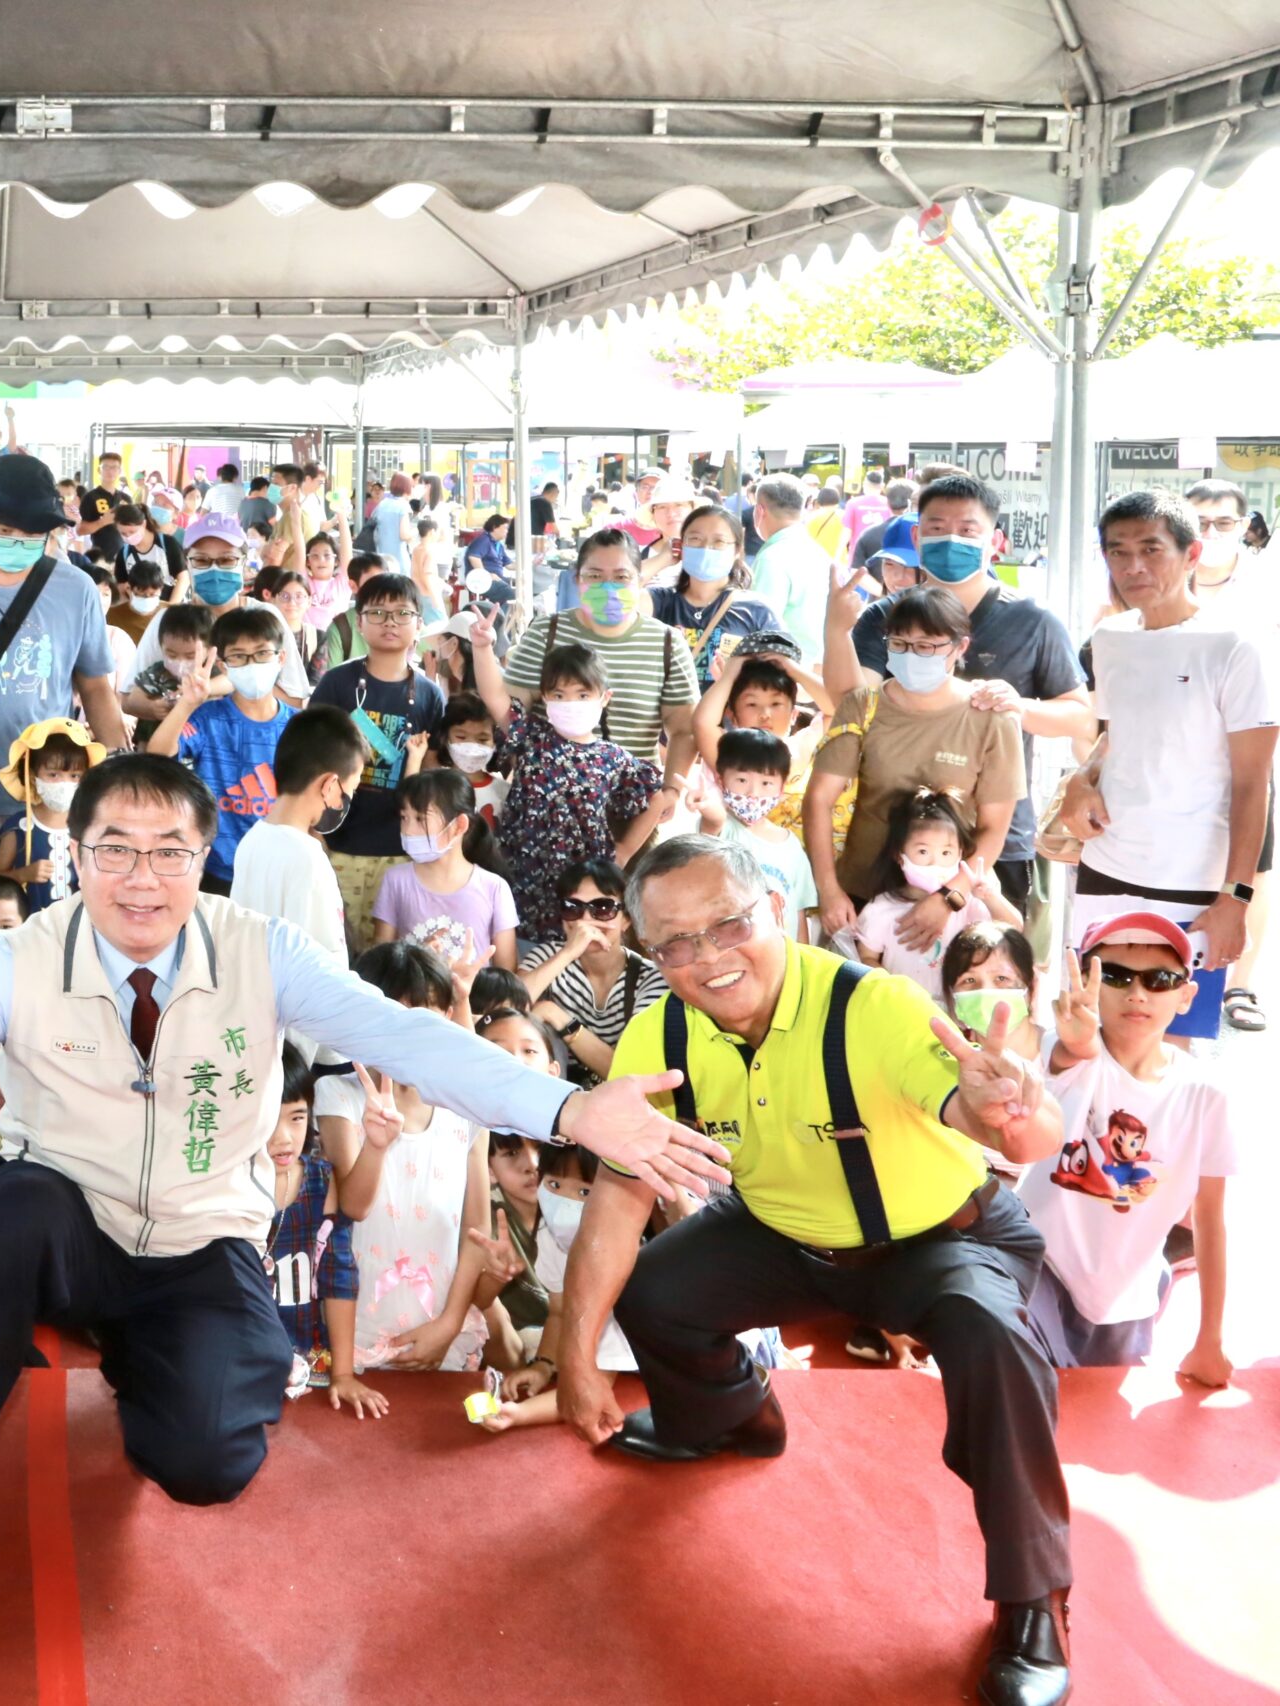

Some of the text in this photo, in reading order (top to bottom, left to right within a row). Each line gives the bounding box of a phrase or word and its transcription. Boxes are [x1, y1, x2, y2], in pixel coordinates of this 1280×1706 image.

[219, 795, 273, 817] adid
[220, 1026, 255, 1100] 市長
[182, 1059, 223, 1174] 黃偉哲
